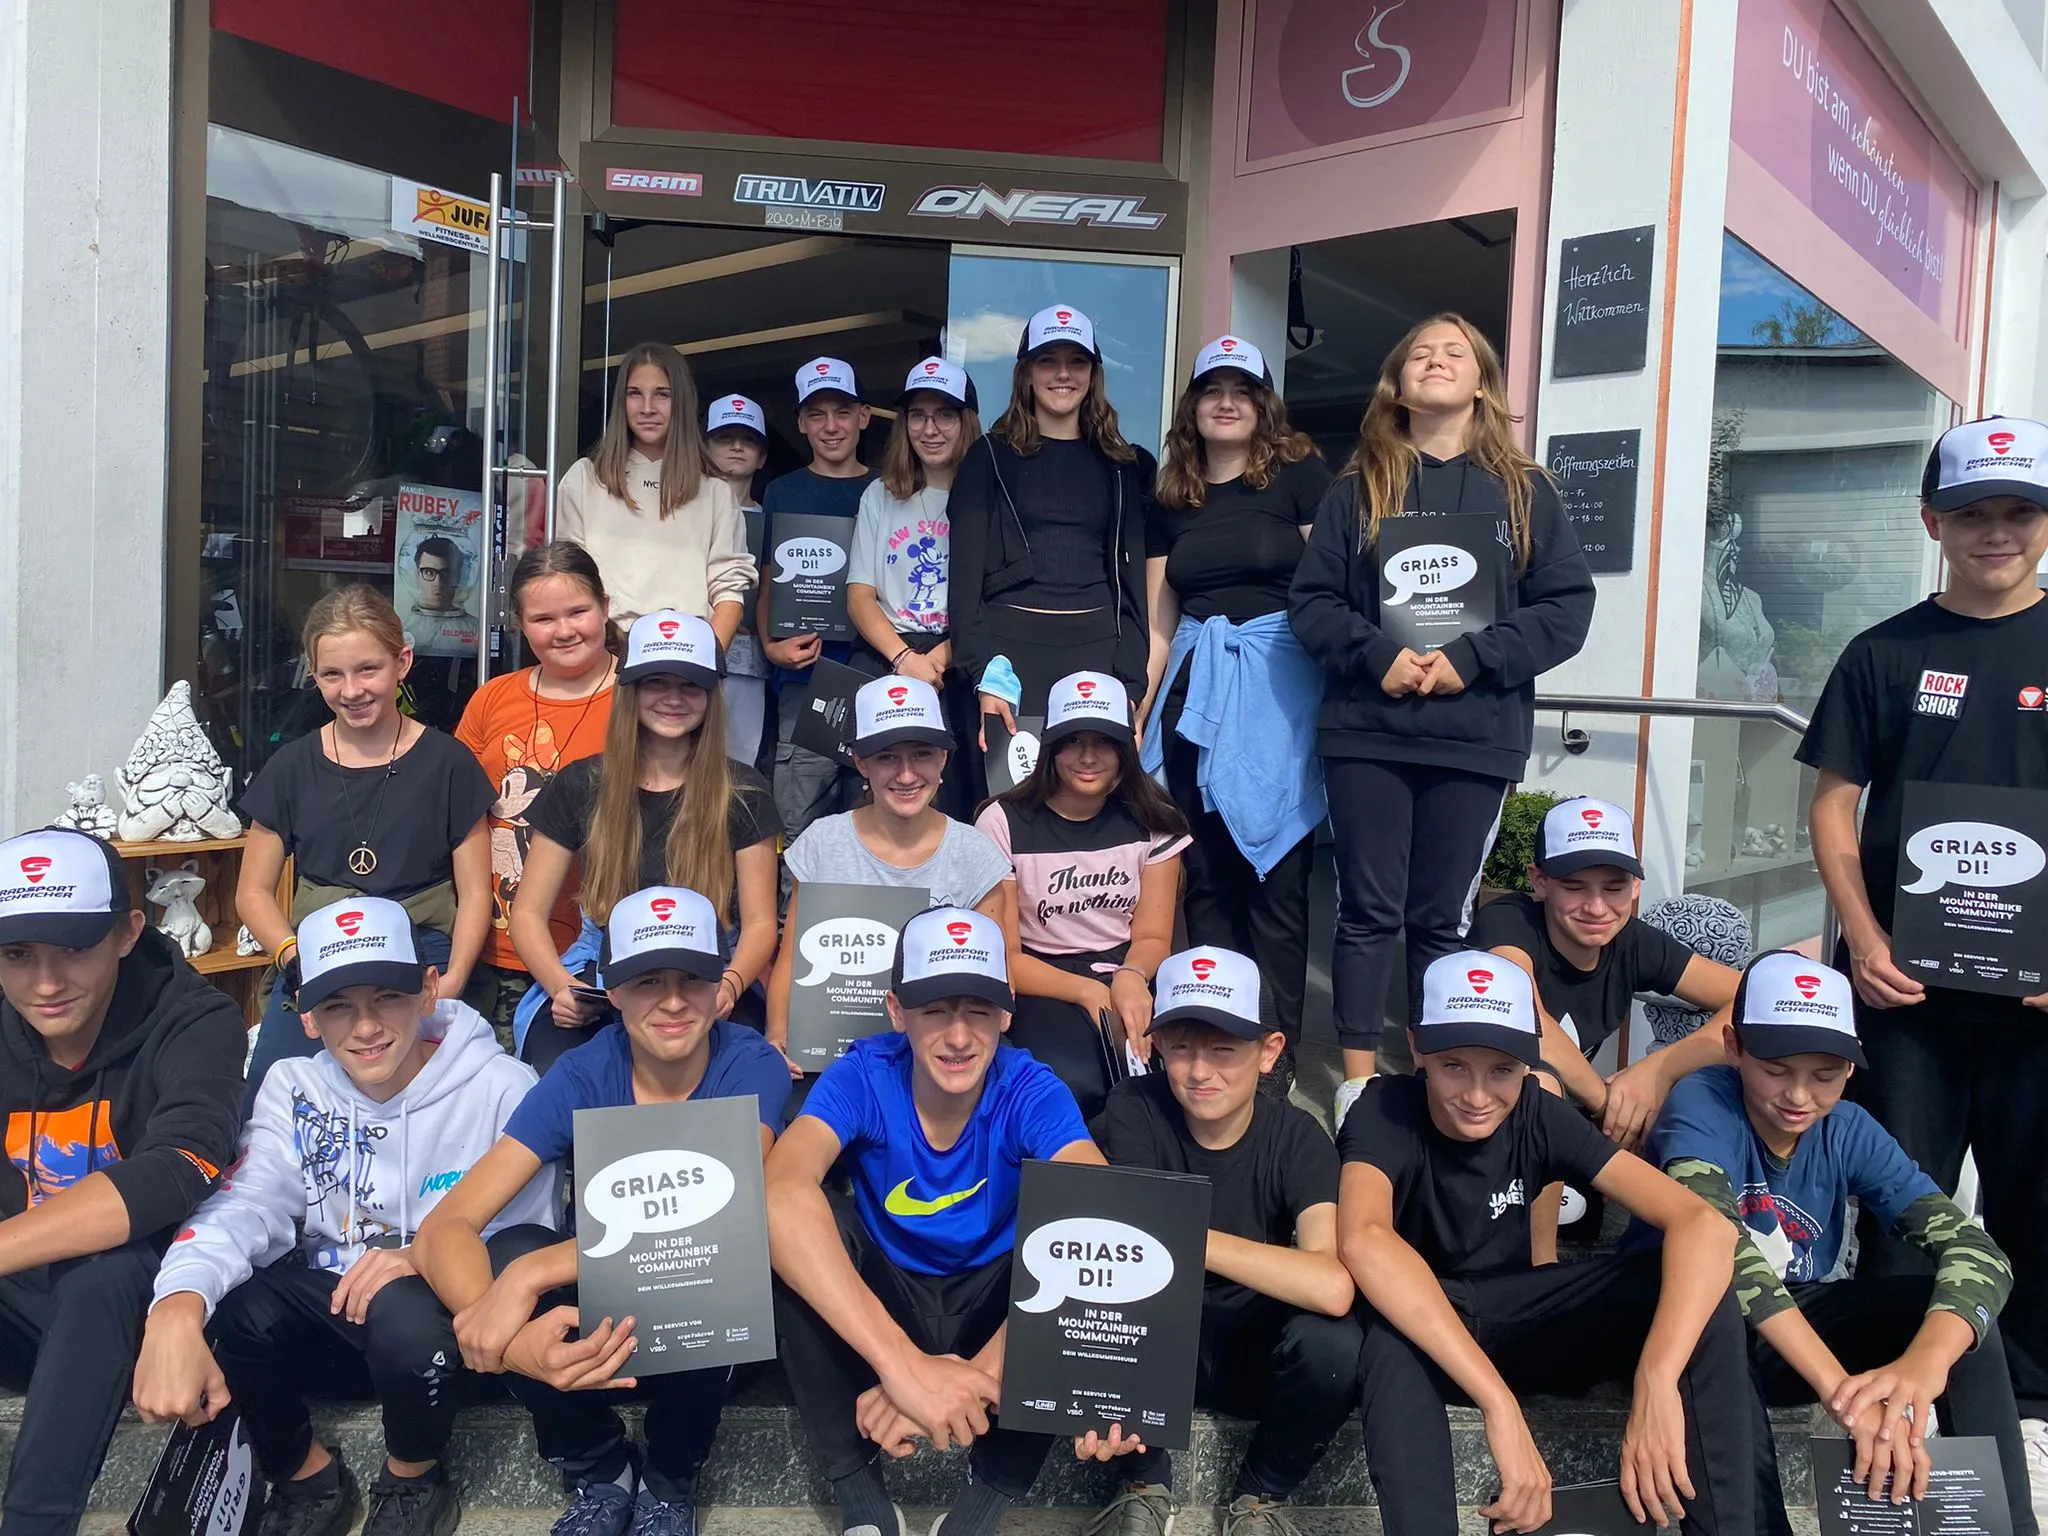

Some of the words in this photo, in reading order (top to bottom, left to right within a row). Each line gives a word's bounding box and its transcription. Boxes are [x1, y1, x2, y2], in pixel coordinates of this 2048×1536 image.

[1783, 25, 1805, 80] DU
[1807, 61, 1830, 112] bist
[1832, 91, 1850, 134] am
[1851, 116, 1909, 206] schönsten,
[611, 173, 698, 191] SRAM
[741, 178, 880, 207] TRUVATIV
[1828, 143, 1859, 199] wenn
[1862, 171, 1878, 216] DU
[1876, 195, 1924, 263] glücklich
[1924, 238, 1943, 283] bist!
[1563, 263, 1636, 291] Herzlich
[1562, 297, 1645, 327] Willkommen
[1964, 461, 2032, 471] SCHEICHER
[1966, 456, 2035, 465] RADSPORT
[400, 492, 459, 517] RUBEY
[787, 548, 833, 558] GRIASS
[886, 554, 898, 565] 19
[801, 560, 819, 569] DI!
[1400, 556, 1459, 572] GRIASS
[1420, 573, 1441, 585] DI!
[1410, 602, 1465, 611] MOUNTAINBIKE
[1923, 673, 1965, 695] ROCK
[1917, 693, 1959, 717] SHOX
[1930, 839, 2018, 856] GRIASS
[1957, 859, 1989, 875] DI!
[1047, 864, 1132, 895] Thanks
[0, 885, 77, 896] RADSPORT
[1963, 890, 1975, 899] IN
[1977, 891, 1999, 901] DER
[1939, 896, 2023, 913] MOUNTAINBIKE
[1037, 899, 1065, 927] for
[1945, 906, 2015, 920] COMMUNITY
[632, 929, 694, 943] SCHEICHER
[633, 924, 697, 936] RADSPORT
[319, 935, 388, 953] RADSPORT
[818, 933, 886, 948] GRIASS
[318, 942, 386, 960] SCHEICHER
[840, 951, 865, 965] DI!
[929, 947, 990, 957] RADSPORT
[927, 954, 988, 964] SCHEICHER
[856, 980, 873, 988] DER
[1172, 983, 1235, 993] RADSPORT
[831, 995, 884, 1005] COMMUNITY
[1170, 987, 1231, 999] SCHEICHER
[1444, 1003, 1510, 1015] SCHEICHER
[1447, 996, 1514, 1008] RADSPORT
[1775, 1000, 1840, 1012] RADSPORT
[1772, 1006, 1838, 1018] SCHEICHER
[610, 1166, 705, 1199] GRIASS
[643, 1196, 679, 1219] DI!
[654, 1238, 669, 1249] IN
[670, 1236, 693, 1248] DER
[629, 1244, 719, 1264] MOUNTAINBIKE
[1049, 1240, 1144, 1263] GRIASS
[637, 1257, 712, 1274] COMMUNITY
[1078, 1267, 1113, 1288] DI!
[1084, 1308, 1098, 1319] IN
[1100, 1310, 1123, 1322] DER
[1058, 1317, 1148, 1336] MOUNTAINBIKE
[1064, 1329, 1139, 1346] COMMUNITY
